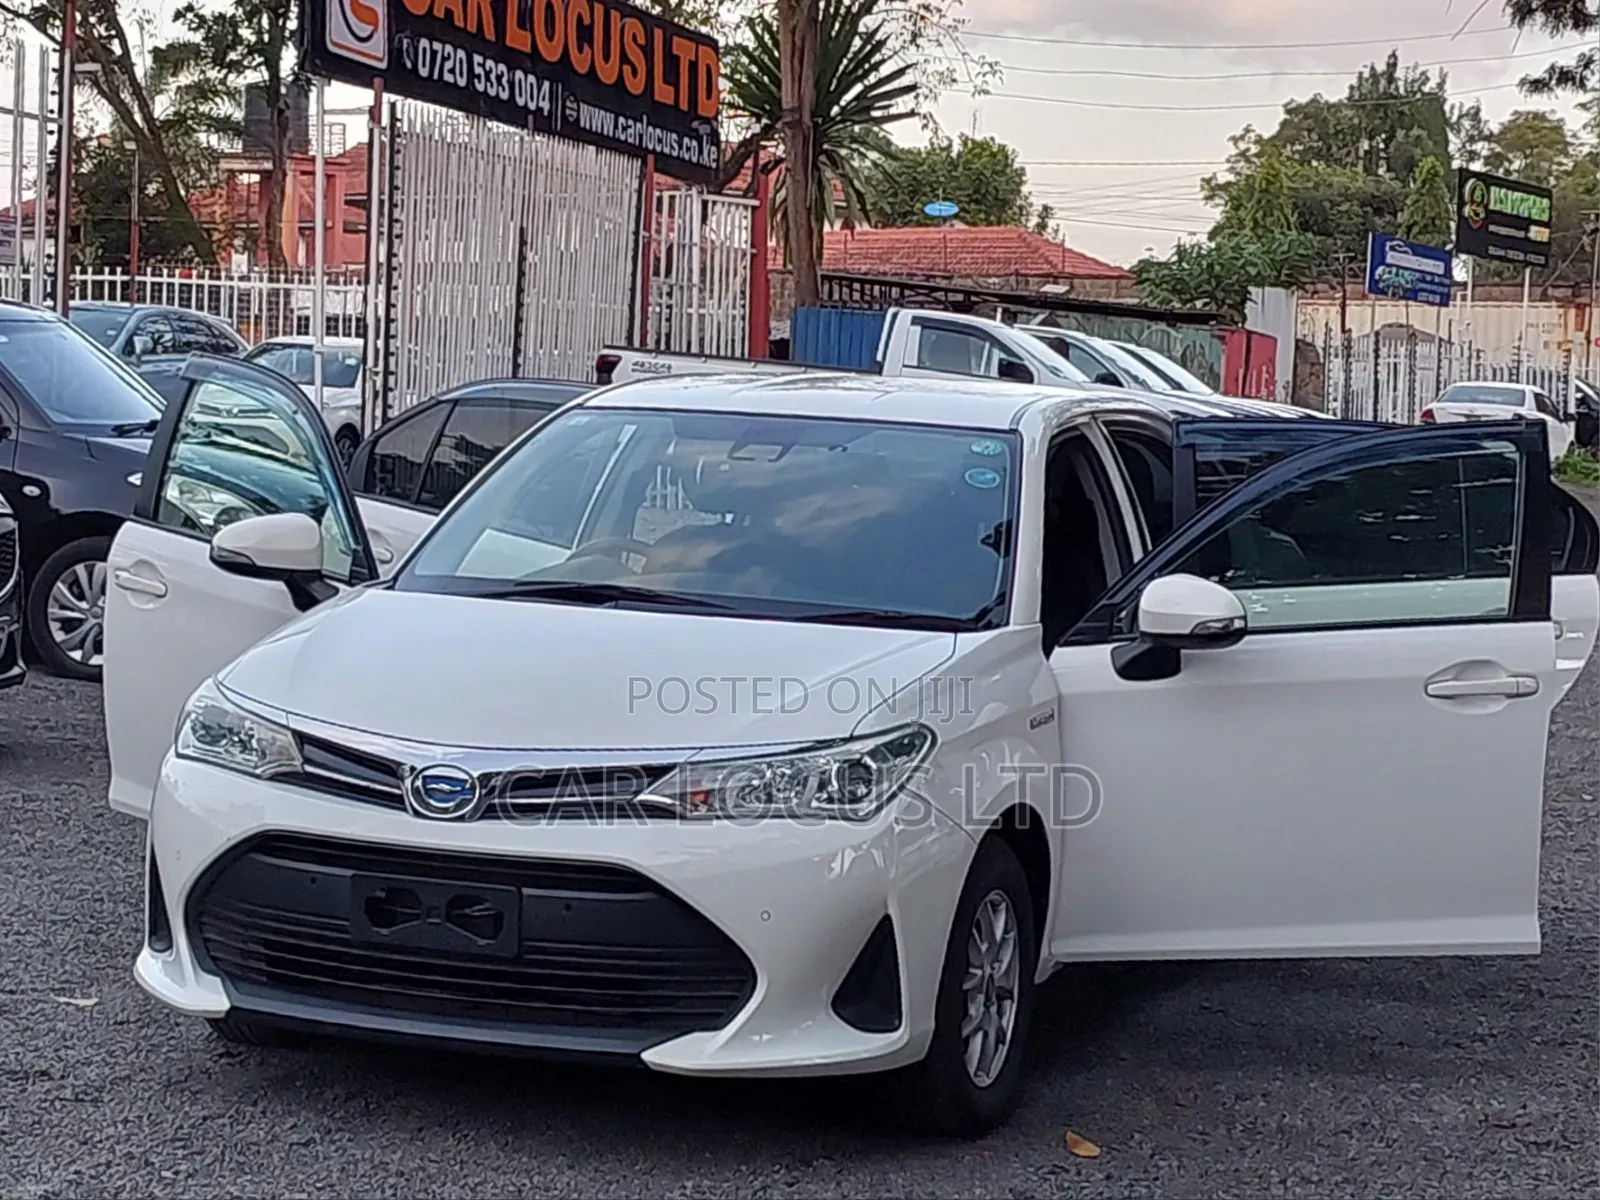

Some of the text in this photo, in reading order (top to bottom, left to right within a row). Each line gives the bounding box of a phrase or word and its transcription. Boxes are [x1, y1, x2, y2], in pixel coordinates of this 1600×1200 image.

[417, 37, 718, 170] 0720 533 004 www.carlocus.co.ke
[505, 0, 647, 96] LOCUS
[653, 26, 720, 118] LTD
